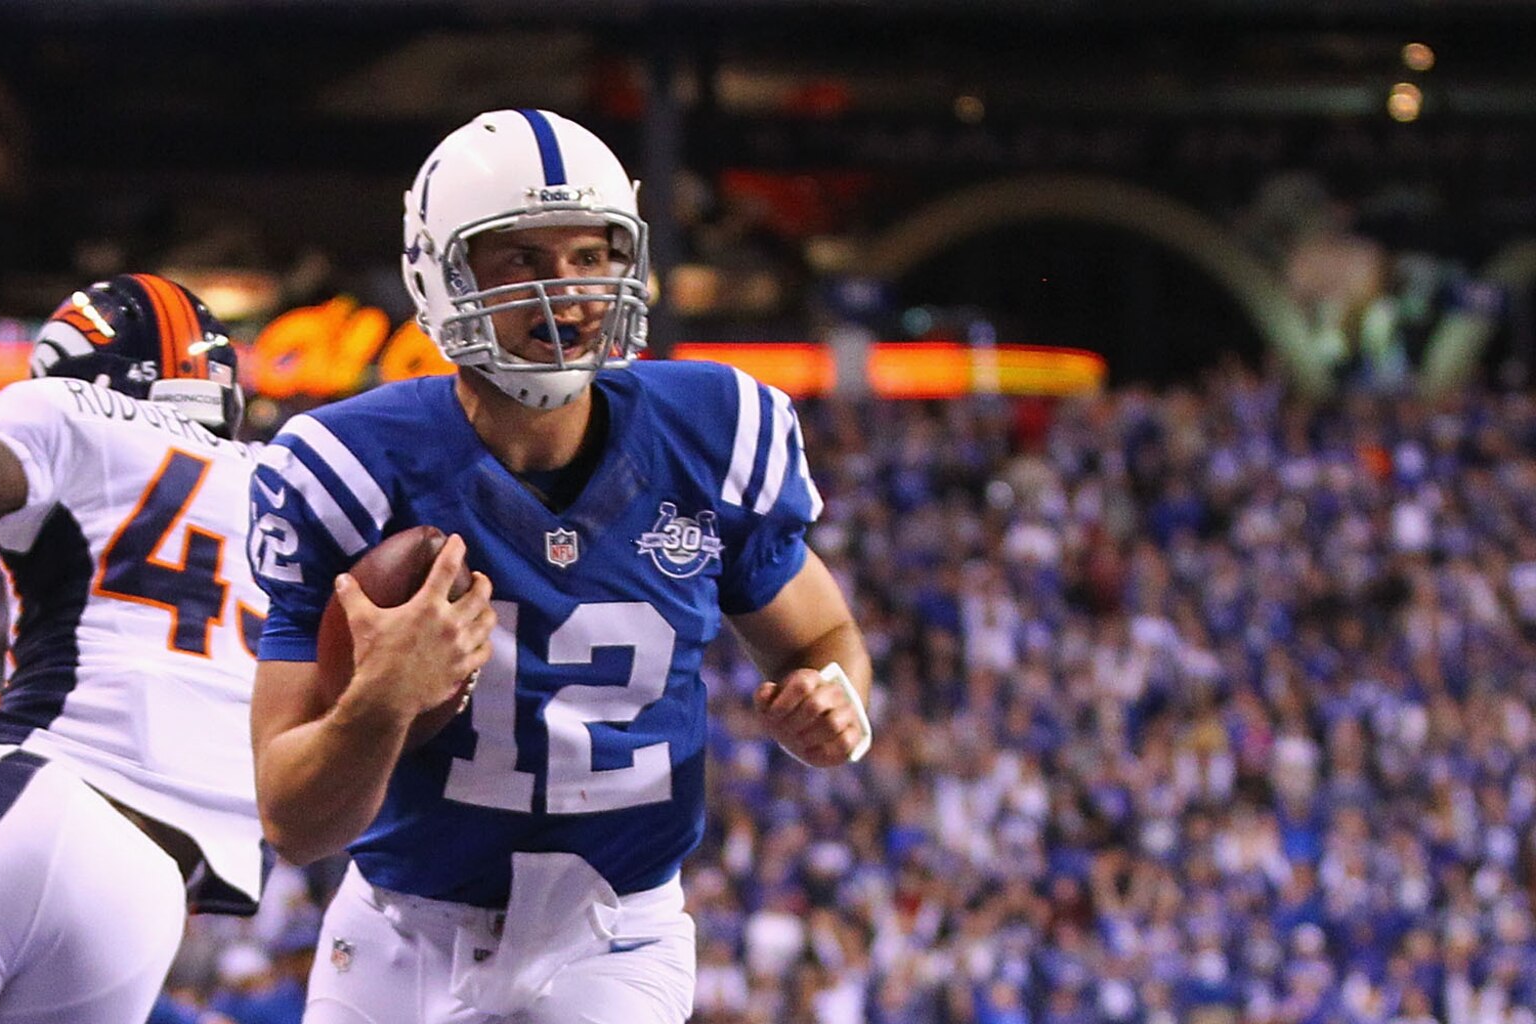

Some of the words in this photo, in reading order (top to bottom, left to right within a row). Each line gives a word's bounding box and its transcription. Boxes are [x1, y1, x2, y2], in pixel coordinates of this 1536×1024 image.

[126, 360, 158, 383] 45
[663, 523, 702, 552] 30
[91, 446, 268, 661] 4
[551, 544, 575, 561] NFL
[443, 600, 676, 815] 12
